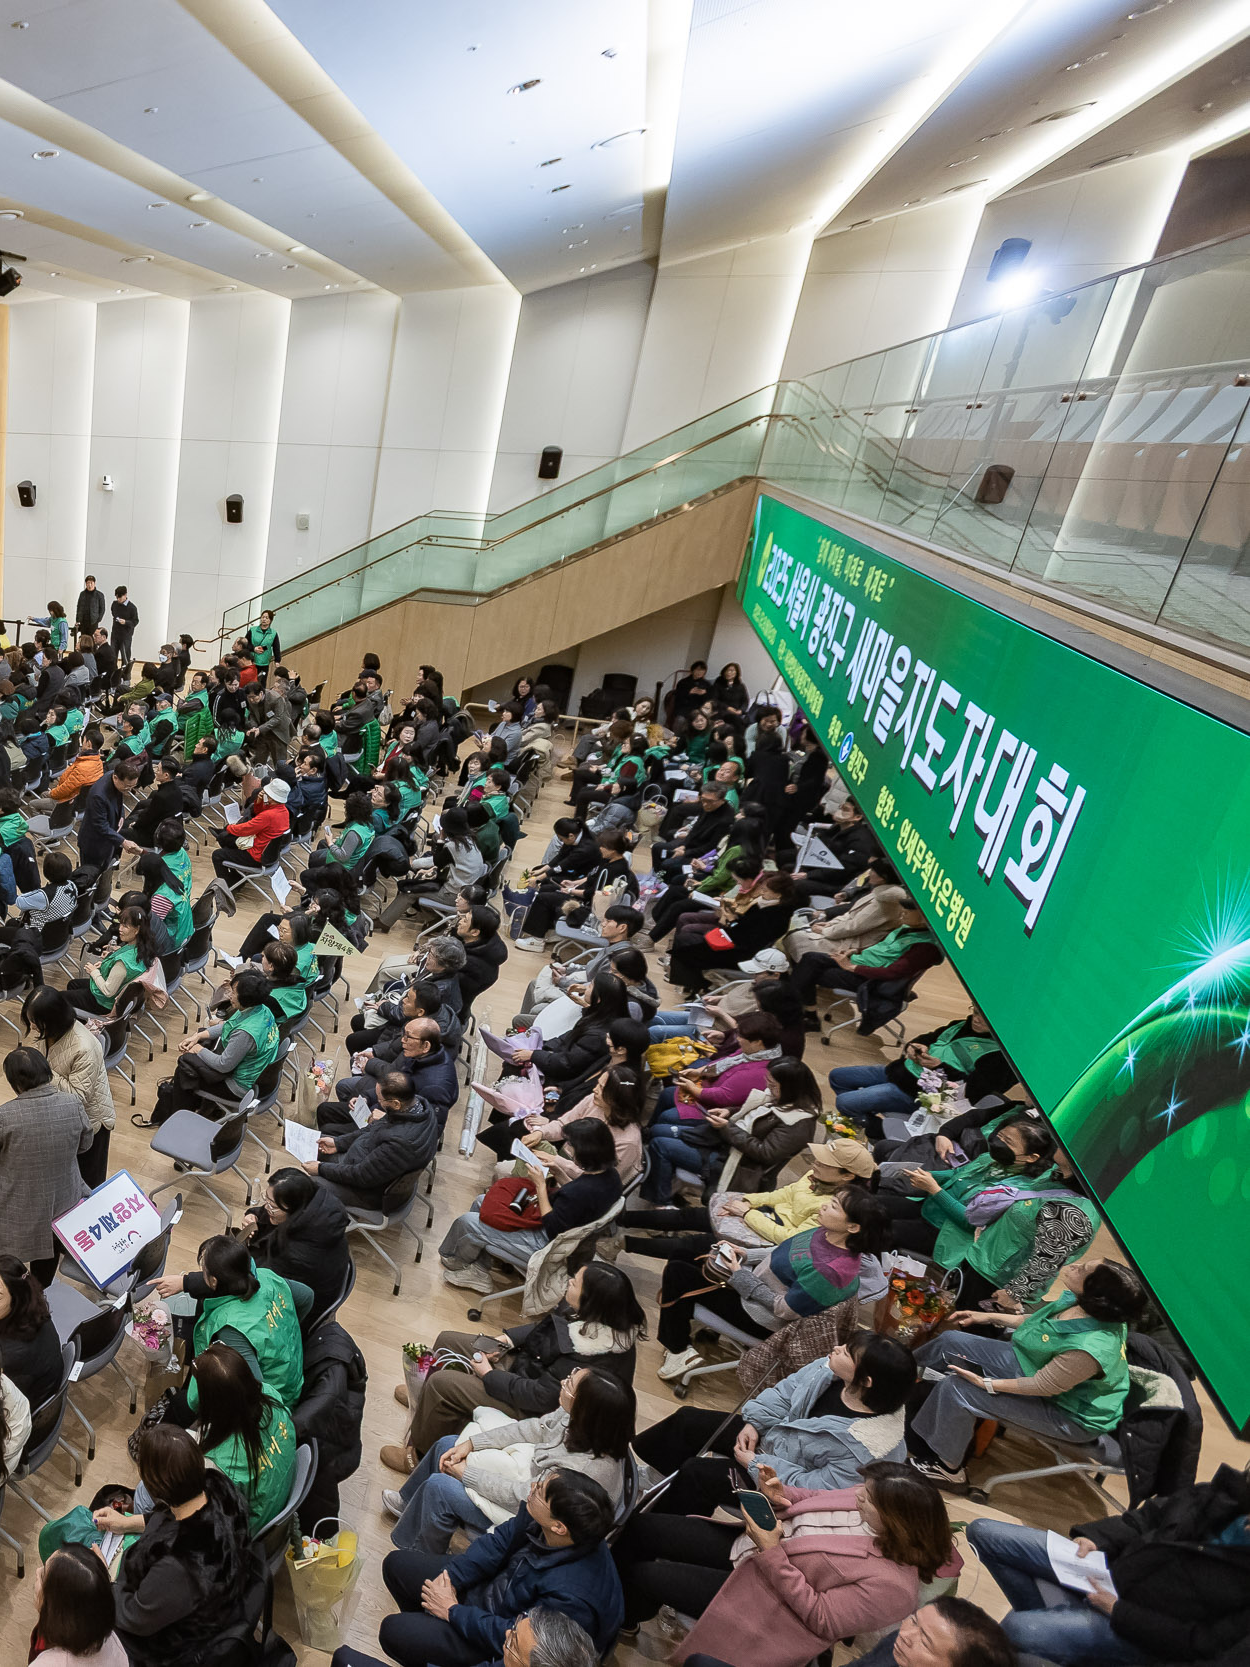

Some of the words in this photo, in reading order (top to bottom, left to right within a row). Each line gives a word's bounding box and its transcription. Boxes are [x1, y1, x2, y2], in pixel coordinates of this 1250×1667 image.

[762, 544, 794, 609] 2025
[785, 561, 821, 642] 서울시
[807, 583, 856, 680] 광진구
[846, 616, 1087, 935] 새마을지도자대회
[847, 743, 869, 785] 광진구
[896, 818, 976, 950] 연세무척나은병원
[73, 1193, 145, 1252] 자양제4동
